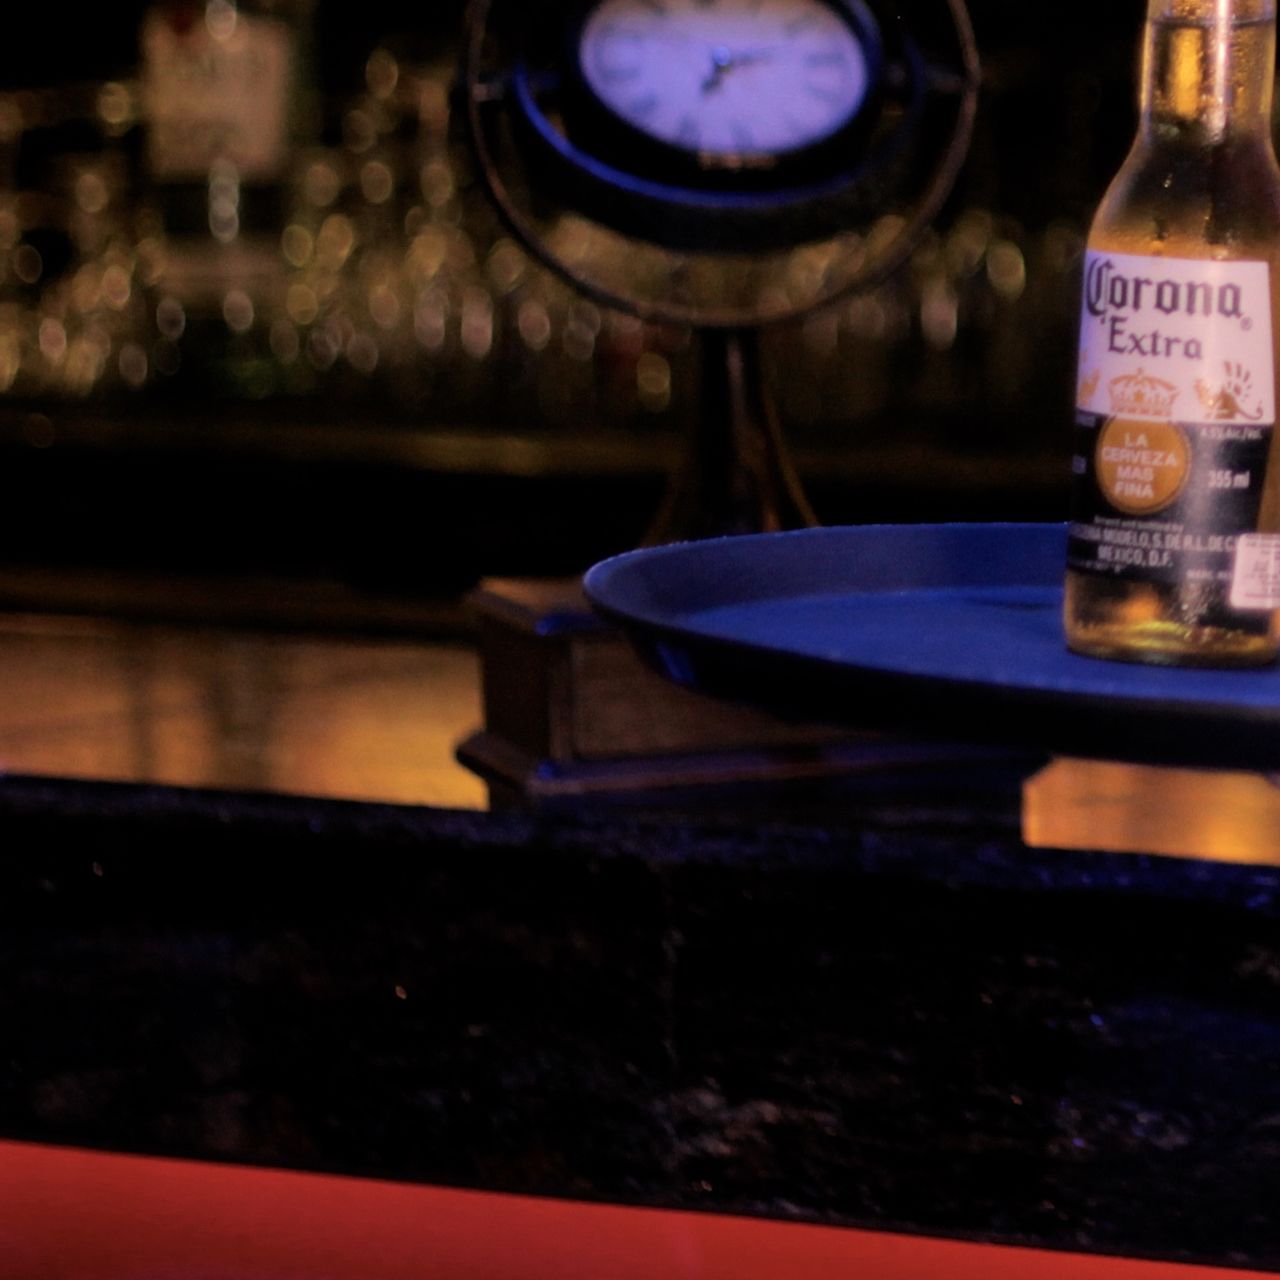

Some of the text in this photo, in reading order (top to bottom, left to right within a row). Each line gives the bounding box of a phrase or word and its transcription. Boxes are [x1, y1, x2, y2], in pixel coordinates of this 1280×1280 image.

[1086, 258, 1243, 324] Corona
[1108, 315, 1203, 360] Extra
[1124, 432, 1148, 448] LA
[1102, 447, 1177, 466] CERVEZA
[1207, 470, 1232, 489] 355
[1113, 481, 1154, 498] FINA
